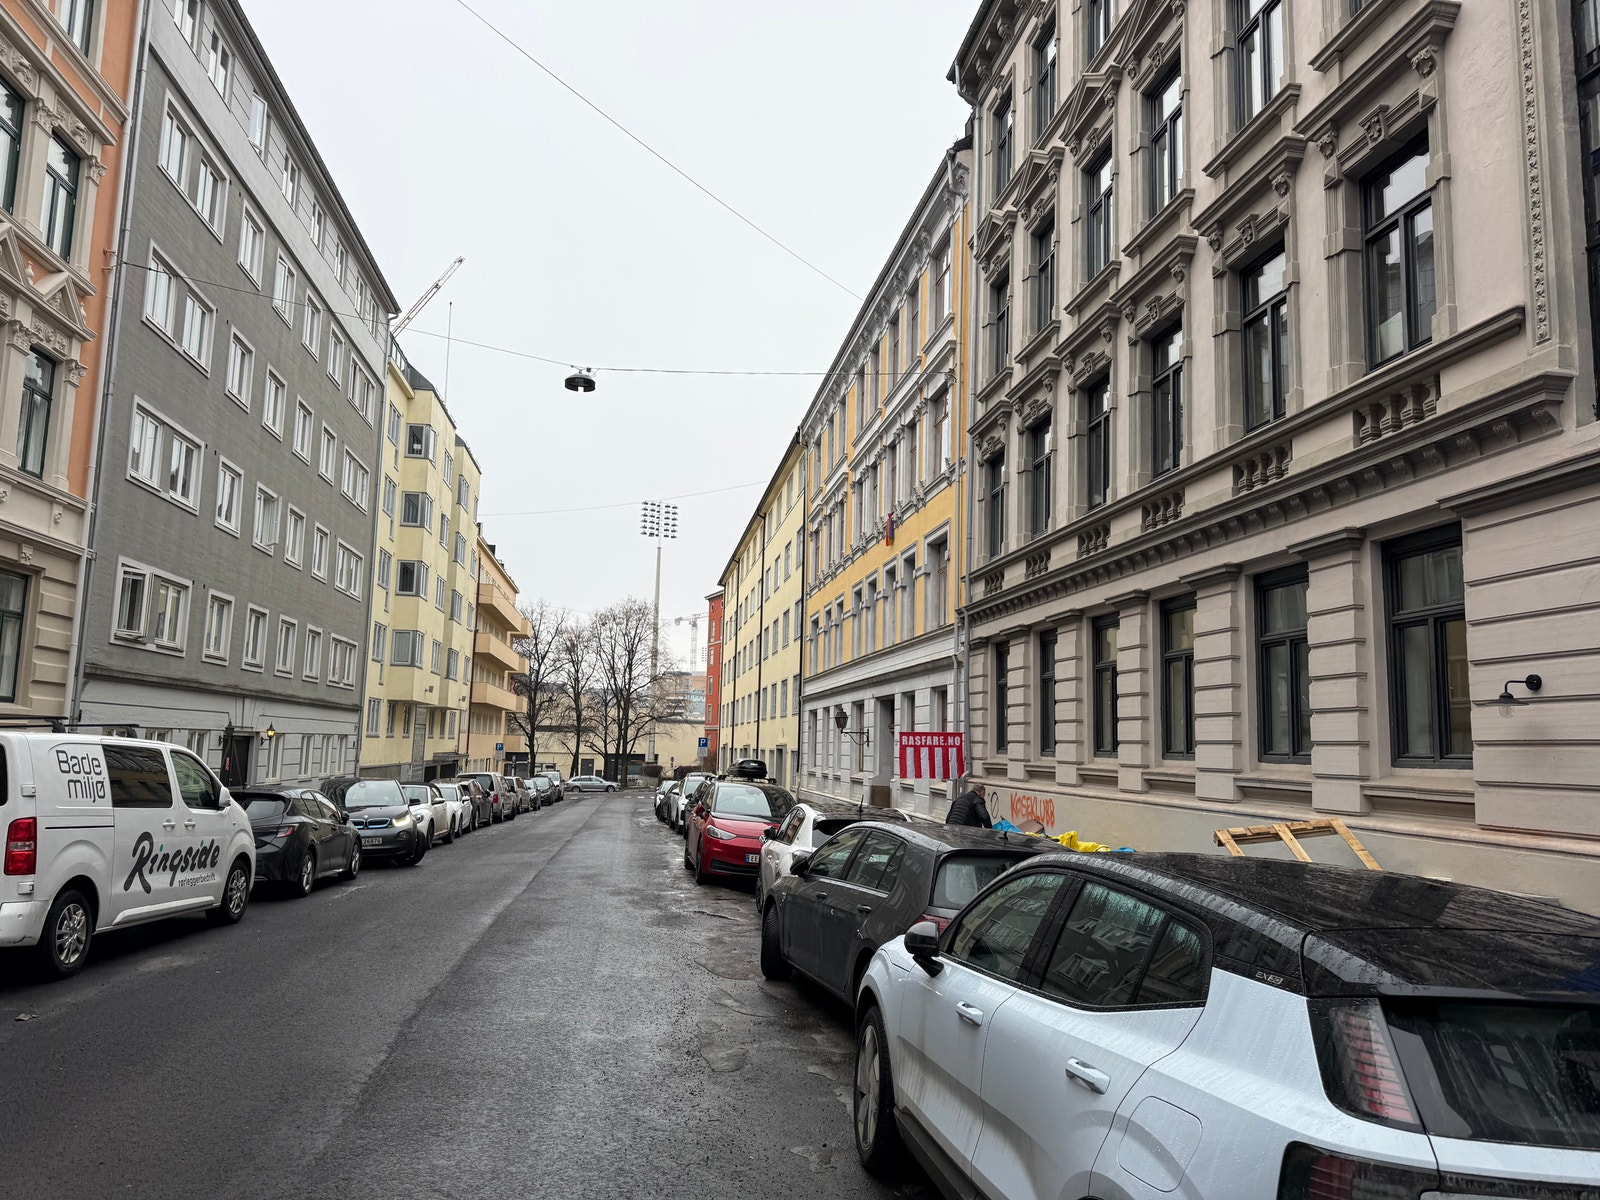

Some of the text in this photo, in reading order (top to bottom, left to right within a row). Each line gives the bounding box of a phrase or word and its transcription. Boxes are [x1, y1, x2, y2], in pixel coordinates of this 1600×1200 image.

[901, 735, 961, 746] RASFARE.NO
[56, 750, 102, 775] Bade
[68, 776, 106, 803] miljø
[123, 831, 220, 895] Ringside
